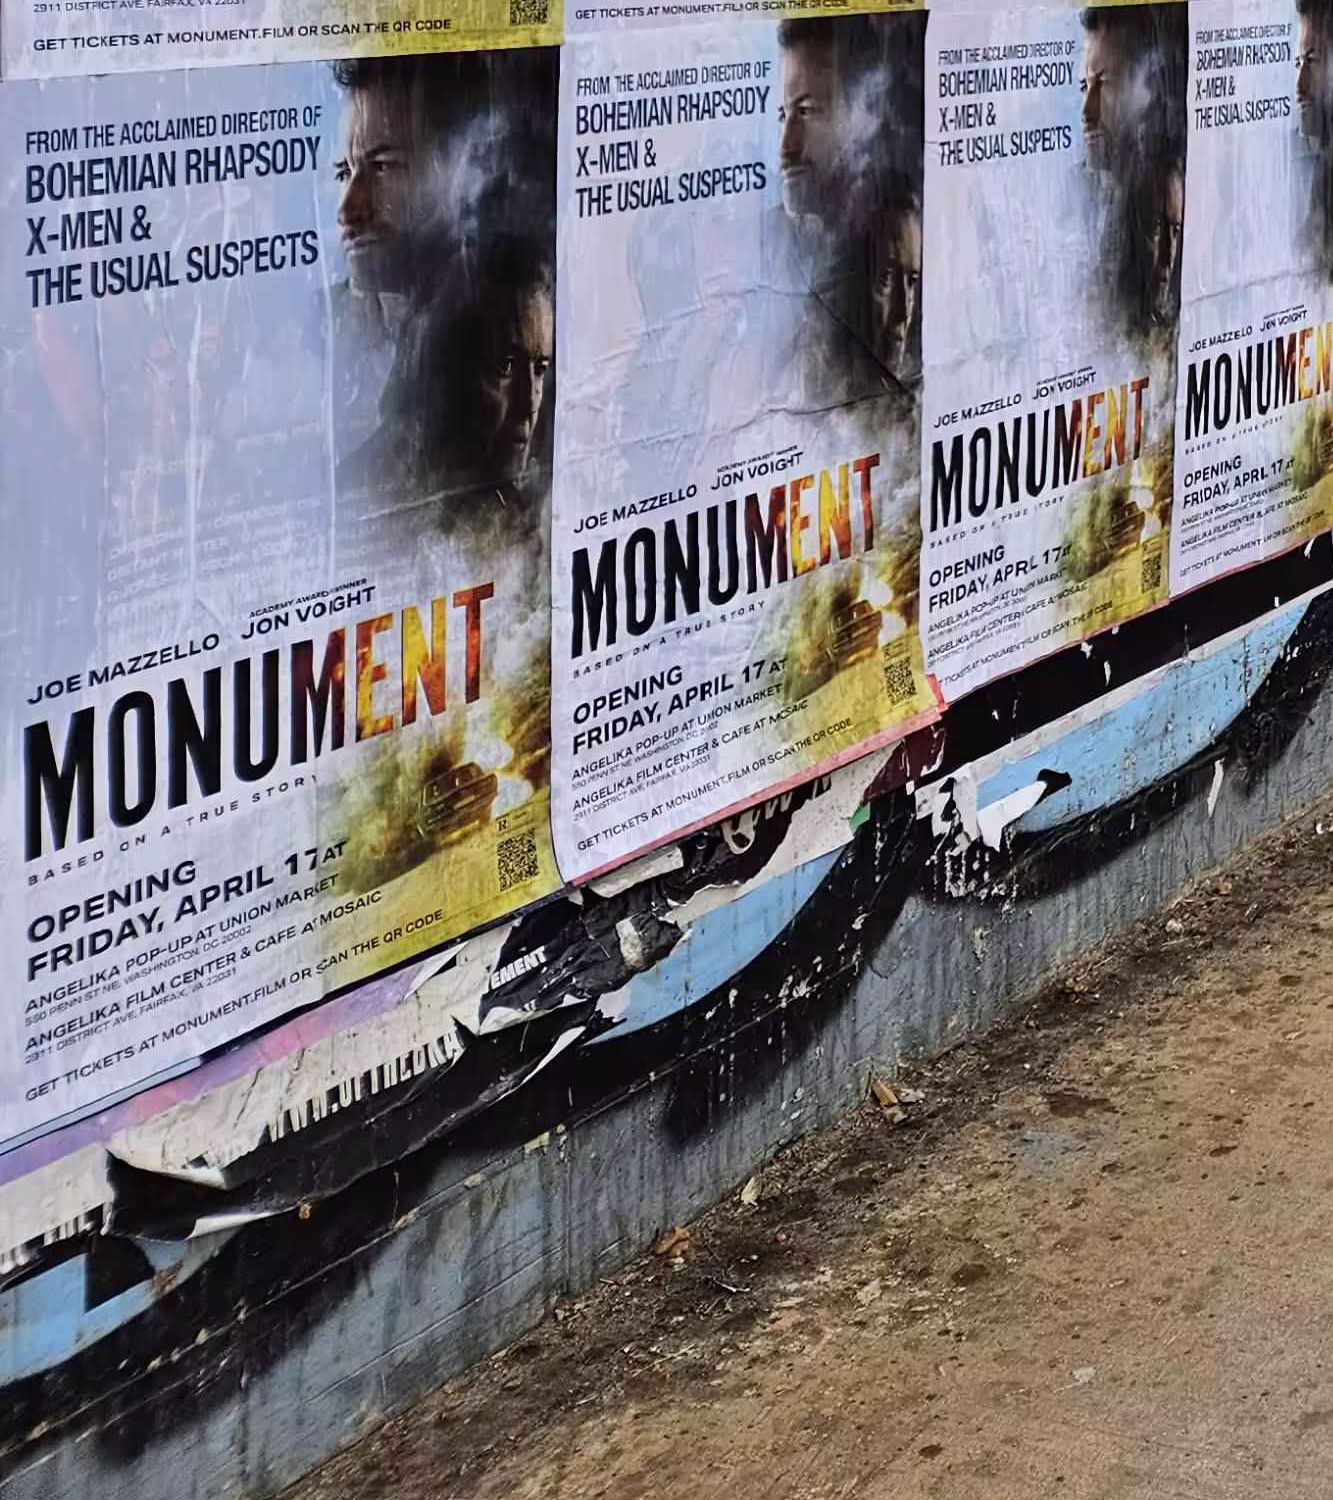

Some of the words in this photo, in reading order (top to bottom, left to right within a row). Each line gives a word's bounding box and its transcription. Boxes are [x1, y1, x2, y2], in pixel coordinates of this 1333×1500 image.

[33, 38, 68, 51] GET
[70, 34, 140, 49] TICKETS
[143, 32, 164, 44] AT
[168, 26, 294, 43] MONUMENT.FILM
[298, 25, 318, 37] OR
[321, 23, 361, 38] SCAN
[363, 21, 389, 34] THE
[392, 19, 411, 34] QR
[414, 19, 451, 34] CODE
[939, 66, 1007, 98] BOHEMIAN
[1011, 61, 1074, 91] RHAPSODY
[576, 96, 673, 136] BOHEMIAN
[677, 86, 770, 124] RHAPSODY
[26, 150, 176, 204] BOHEMIAN
[185, 135, 320, 185] RHAPSODY
[26, 209, 124, 257] X-MEN
[130, 203, 152, 242] &
[930, 377, 1150, 533] MONUMENT
[1184, 455, 1242, 488] OPENING
[571, 453, 880, 659] MONUMENT
[929, 544, 1005, 588] OPENING
[24, 582, 495, 863] MONUMENT
[574, 666, 682, 725] OPENING
[27, 860, 196, 943] OPENING
